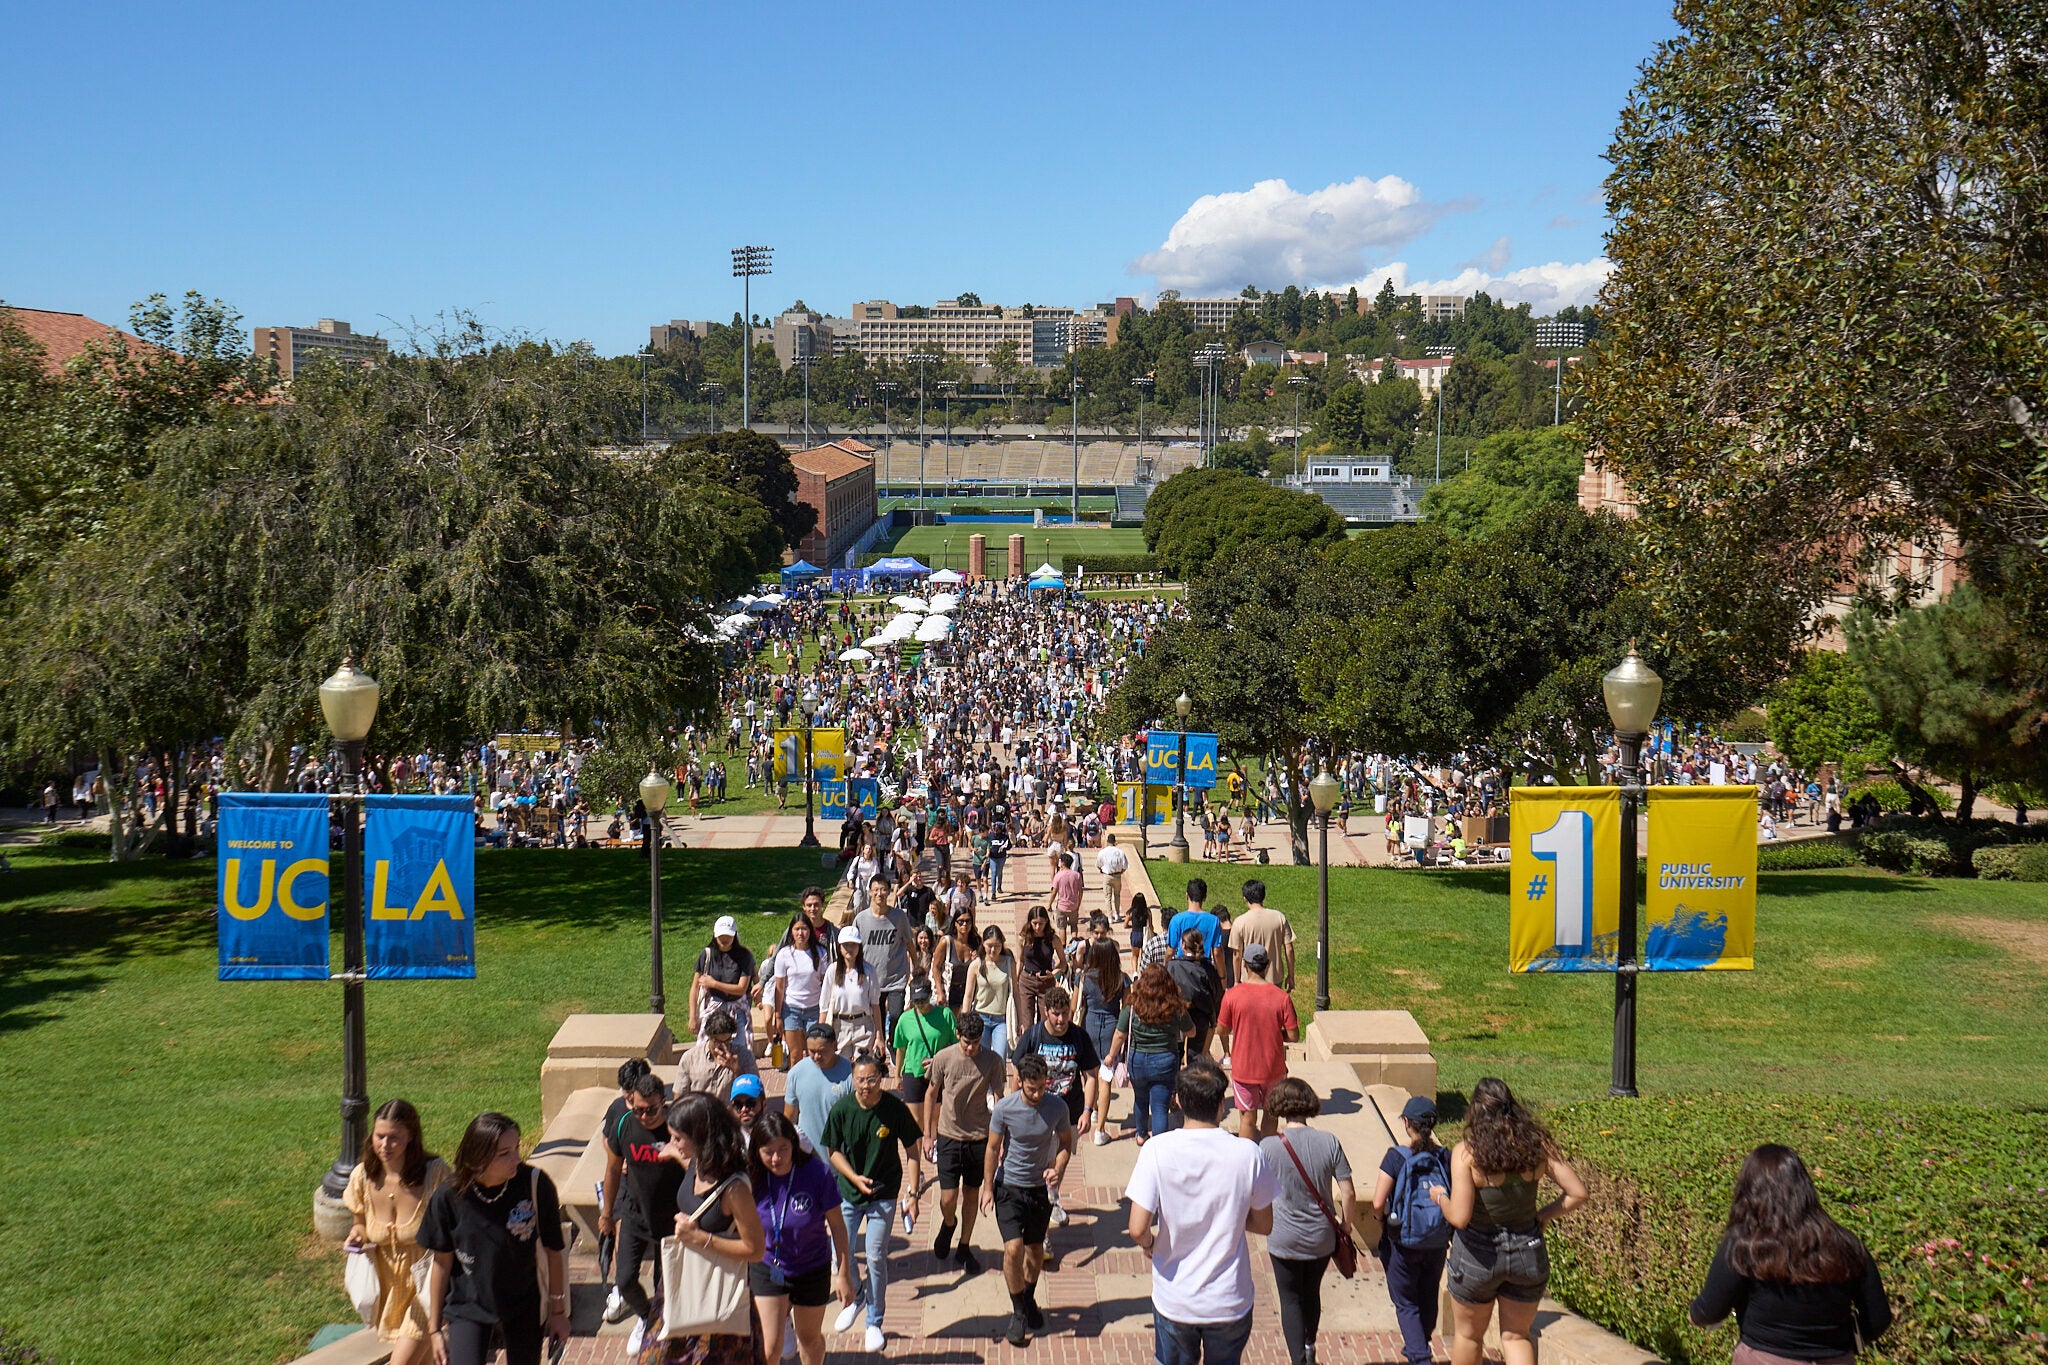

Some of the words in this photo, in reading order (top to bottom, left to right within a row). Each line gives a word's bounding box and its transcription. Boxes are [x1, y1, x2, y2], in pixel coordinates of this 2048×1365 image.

[1148, 749, 1178, 769] UC
[1186, 751, 1214, 771] LA
[822, 791, 845, 807] UC
[227, 840, 276, 849] WELCOME
[280, 840, 294, 849] TO
[1660, 863, 1712, 876] PUBLIC
[223, 858, 329, 921] UC
[370, 858, 465, 921] LA
[1659, 876, 1747, 890] UNIVERSITY
[867, 929, 898, 946] NIKE
